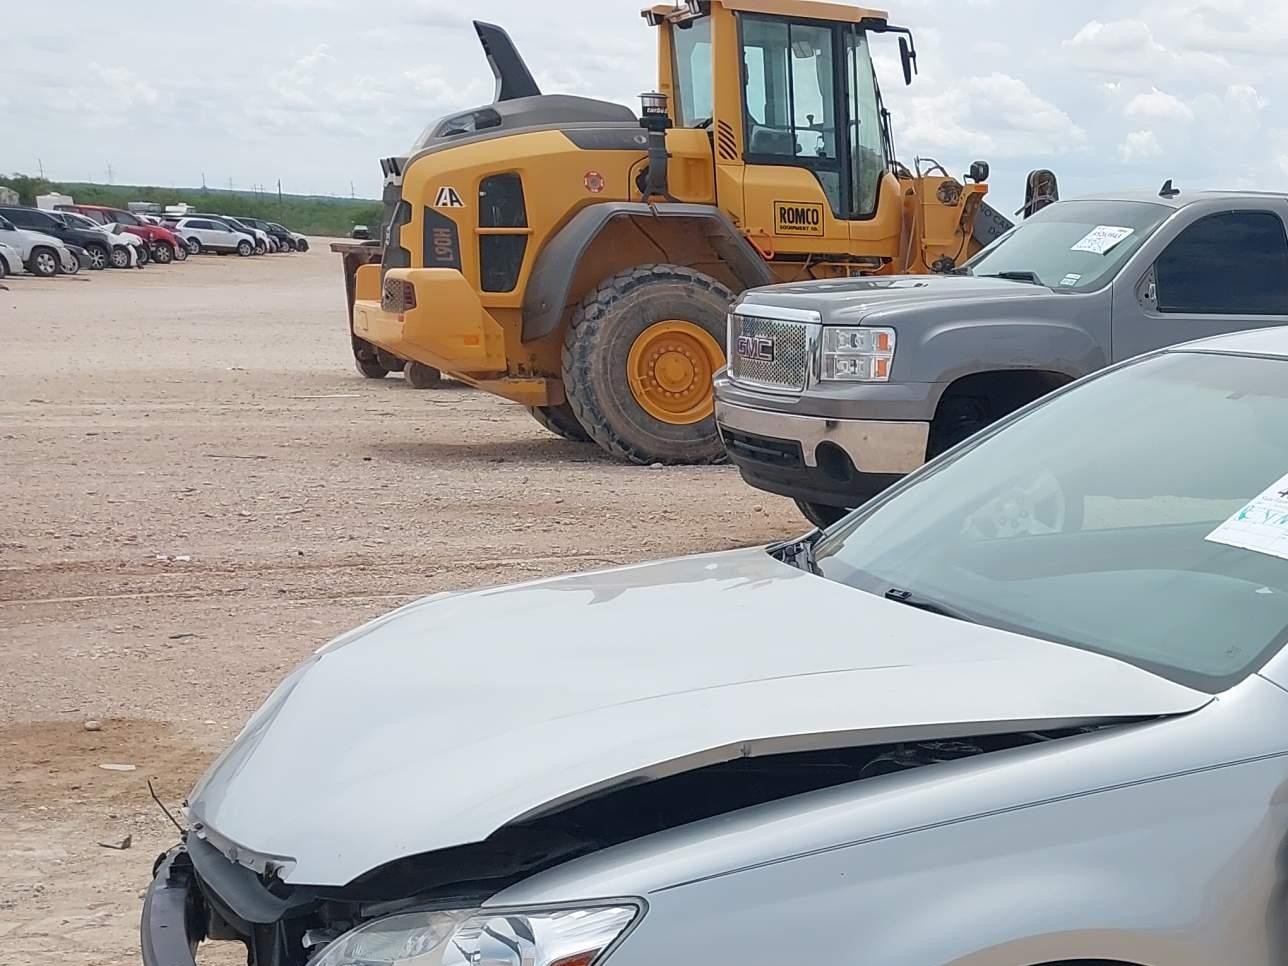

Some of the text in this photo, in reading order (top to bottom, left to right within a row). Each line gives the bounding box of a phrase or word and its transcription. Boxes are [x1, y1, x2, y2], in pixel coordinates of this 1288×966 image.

[779, 207, 819, 225] ROMCO
[433, 228, 454, 262] L90H
[737, 336, 774, 361] GMC
